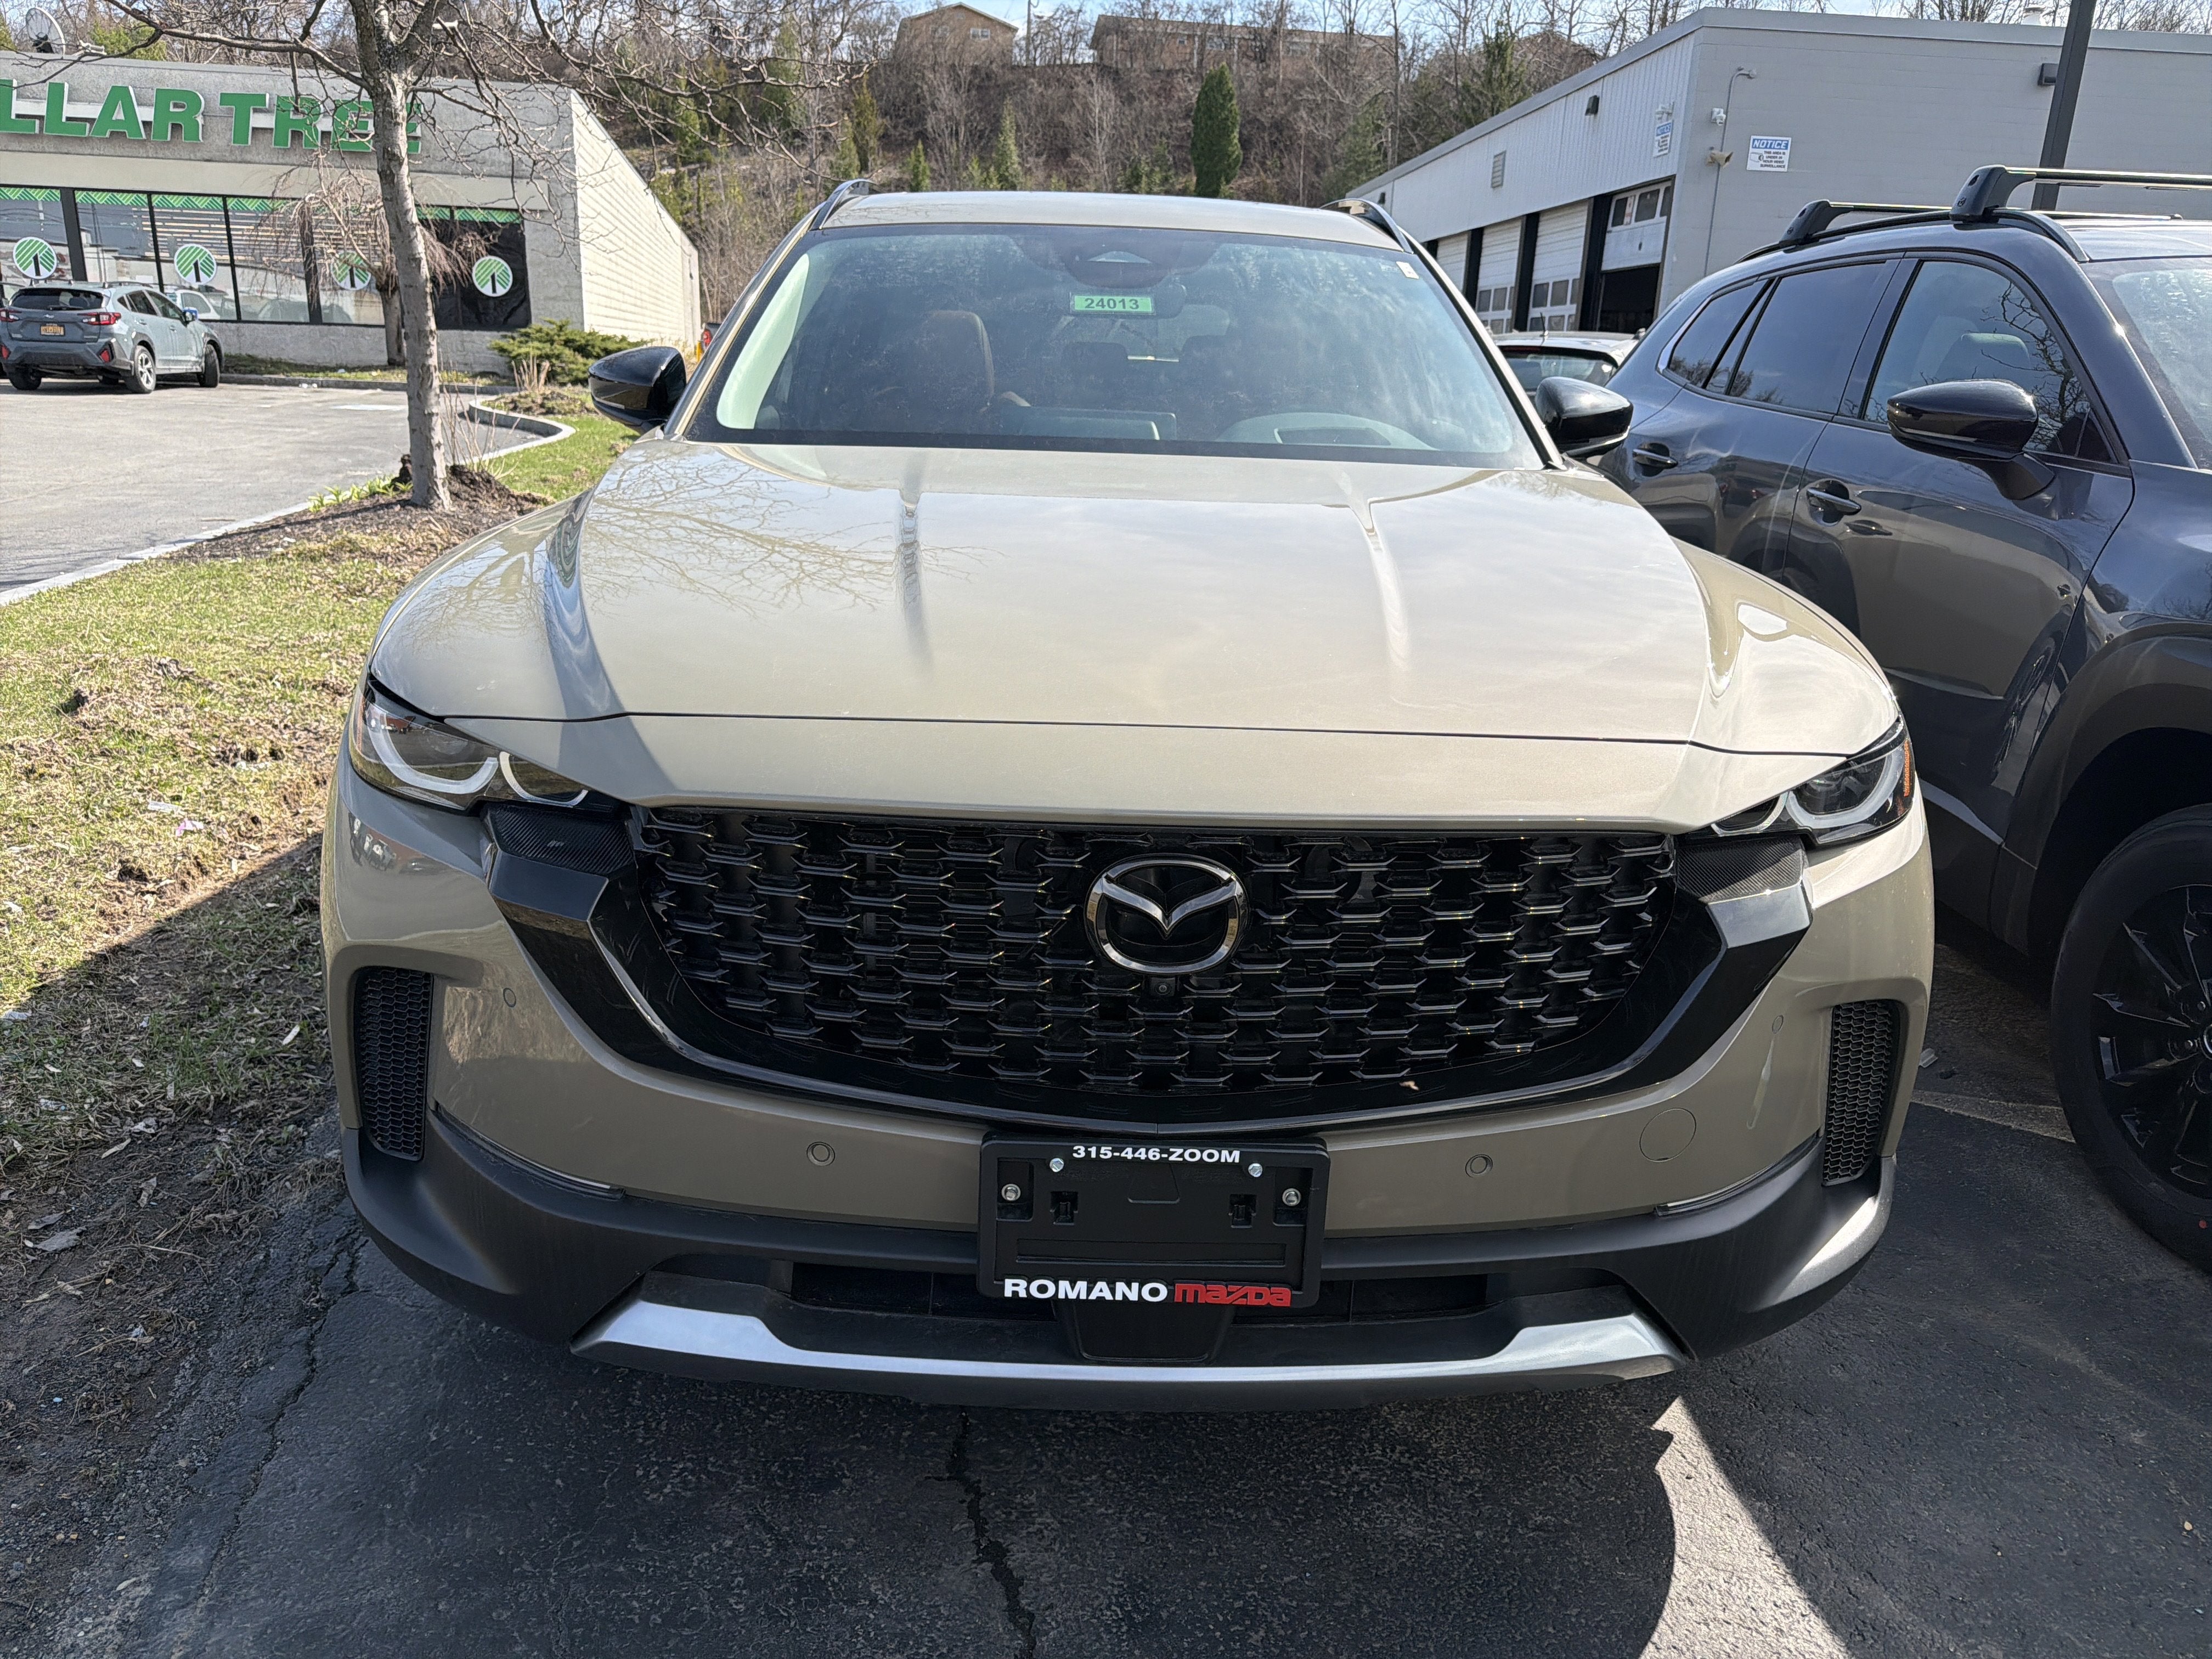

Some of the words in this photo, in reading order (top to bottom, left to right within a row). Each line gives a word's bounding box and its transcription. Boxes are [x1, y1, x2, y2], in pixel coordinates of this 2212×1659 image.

[1753, 139, 1787, 149] NOTICE
[1084, 298, 1139, 310] 24013
[1072, 1146, 1240, 1163] 315-446-ZOOM
[1004, 1279, 1167, 1302] ROMANO
